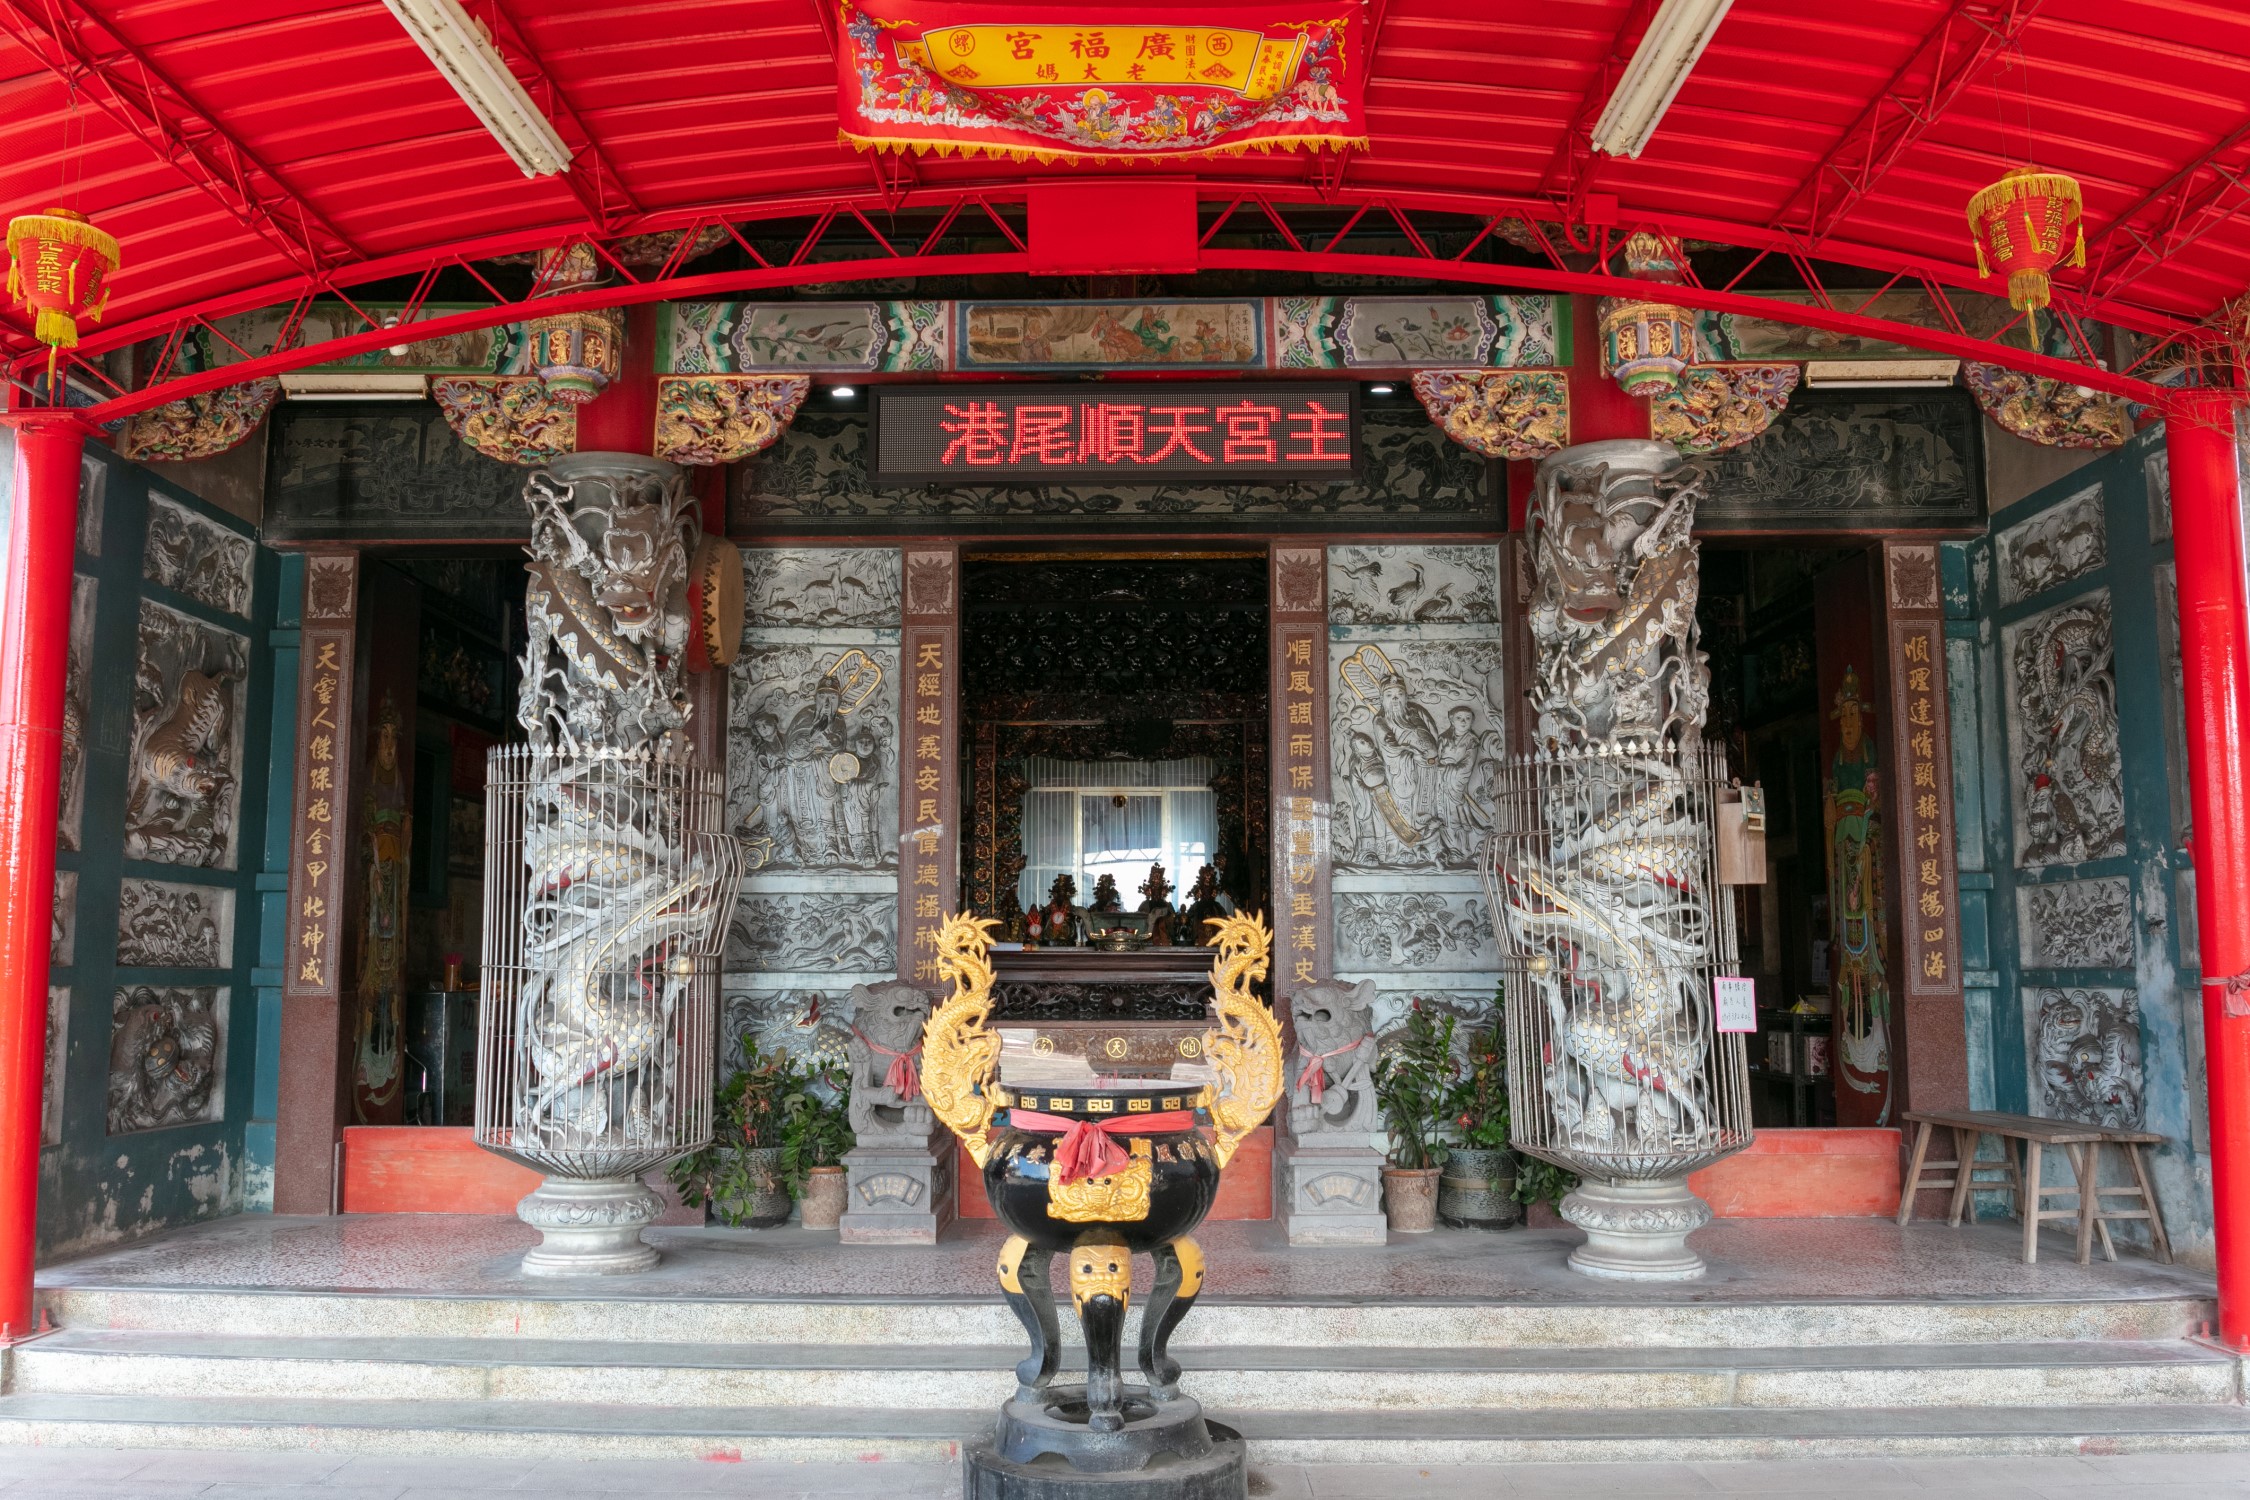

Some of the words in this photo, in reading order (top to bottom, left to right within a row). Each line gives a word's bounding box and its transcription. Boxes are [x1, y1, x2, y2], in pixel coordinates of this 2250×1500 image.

[1005, 31, 1176, 60] 廣福宮
[1185, 34, 1196, 81] 財團法人
[1036, 63, 1146, 81] 老大媽
[36, 237, 63, 294] 元辰光彩
[940, 400, 1351, 465] 港尾順天宮主
[1286, 639, 1317, 984] 順風調雨保國豐功垂漢史
